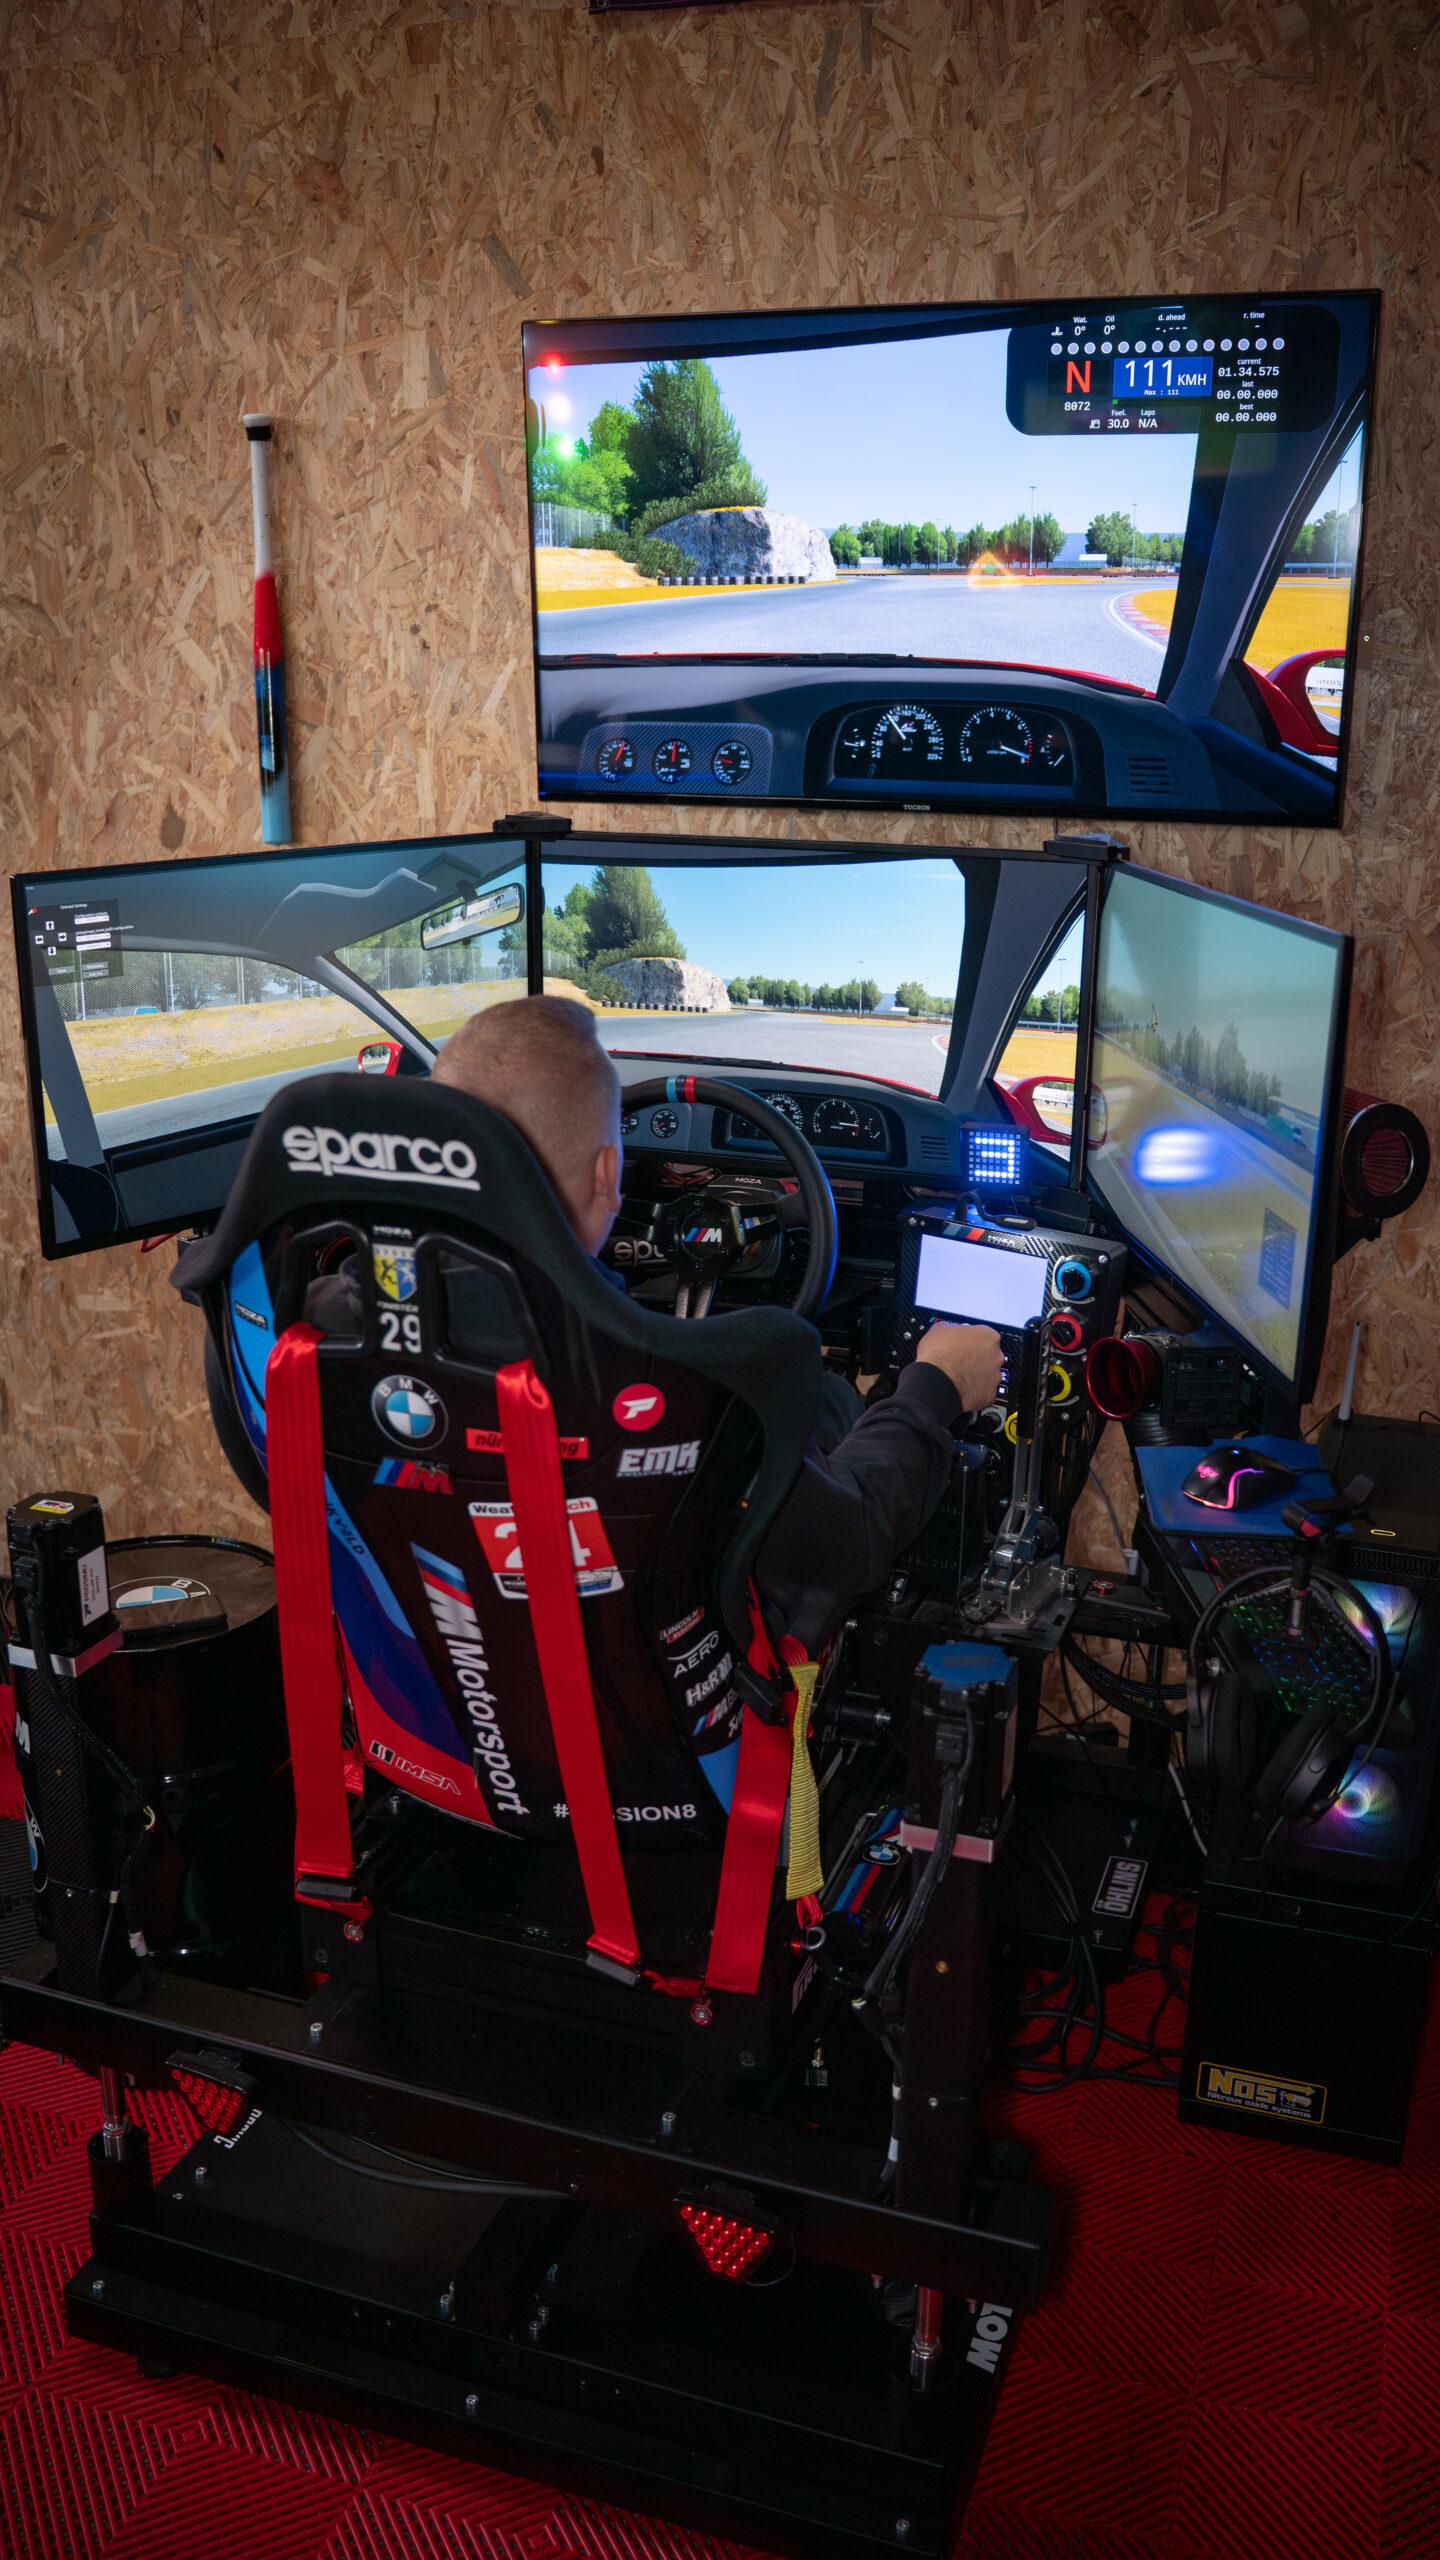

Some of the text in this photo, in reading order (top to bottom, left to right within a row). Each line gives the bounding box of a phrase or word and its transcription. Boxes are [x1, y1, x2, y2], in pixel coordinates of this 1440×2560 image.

[1073, 316, 1088, 324] Wat.
[1105, 315, 1115, 323] Oil
[1166, 313, 1186, 321] ahead
[1065, 360, 1092, 394] N
[1124, 359, 1207, 387] 111 KMH
[1218, 366, 1280, 377] 01.34.575
[1242, 380, 1254, 388] last
[1216, 389, 1278, 400] 00.00.000
[1064, 401, 1091, 411] 8072
[1141, 409, 1156, 417] Laps
[1215, 412, 1277, 422] 00.00.000
[1107, 419, 1129, 429] 30.0
[1138, 418, 1158, 429] N/A
[282, 1125, 478, 1181] sparco
[735, 1177, 762, 1185] MOZA
[379, 1311, 422, 1354] 29
[672, 1632, 720, 1679] AERO
[446, 1637, 531, 1817] Motorsport
[553, 1803, 697, 1822] #SION8
[1096, 1860, 1142, 1913] ÖHLINS
[1208, 2067, 1278, 2105] NOS
[1206, 2090, 1313, 2120] Nitrous oxide systems
